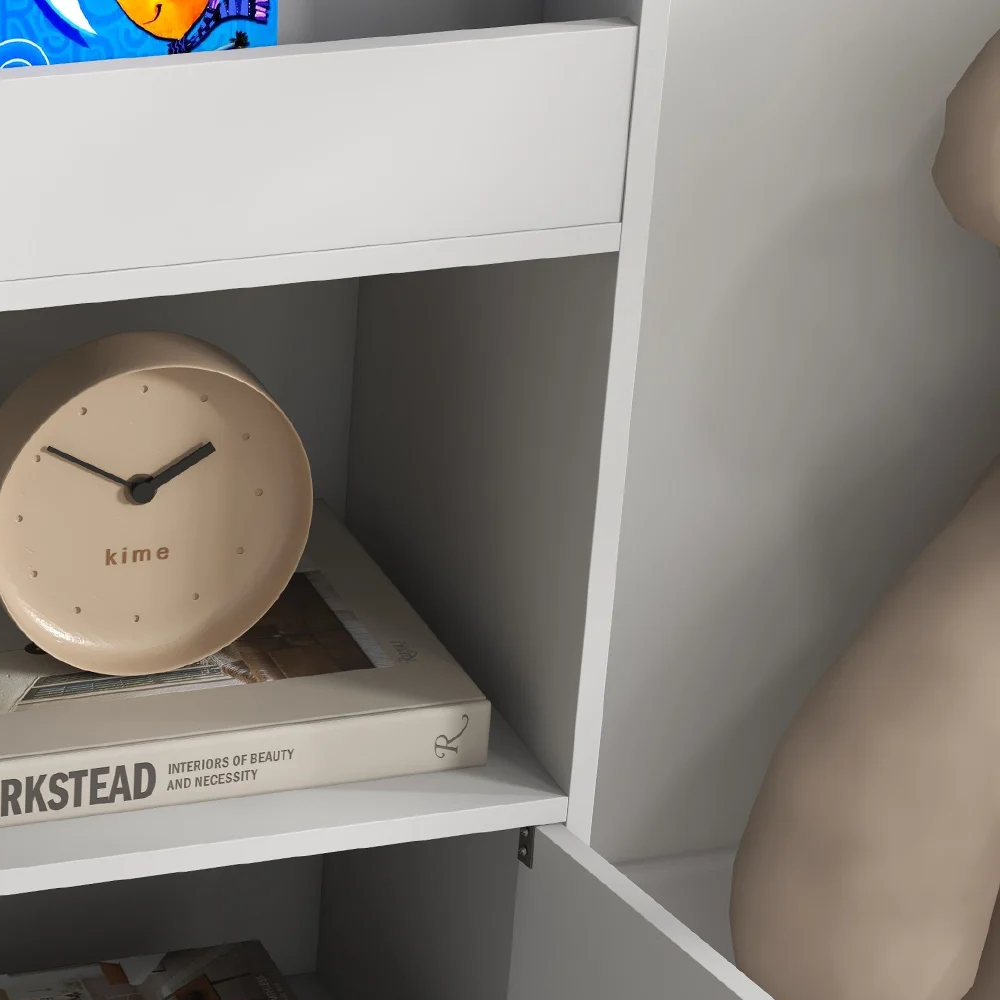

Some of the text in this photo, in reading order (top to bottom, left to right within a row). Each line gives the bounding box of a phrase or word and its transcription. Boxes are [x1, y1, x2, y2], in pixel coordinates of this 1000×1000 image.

[104, 543, 172, 566] kime
[168, 749, 294, 774] INTERIORS OF BEAUTY
[167, 769, 258, 791] AND NECESSITY
